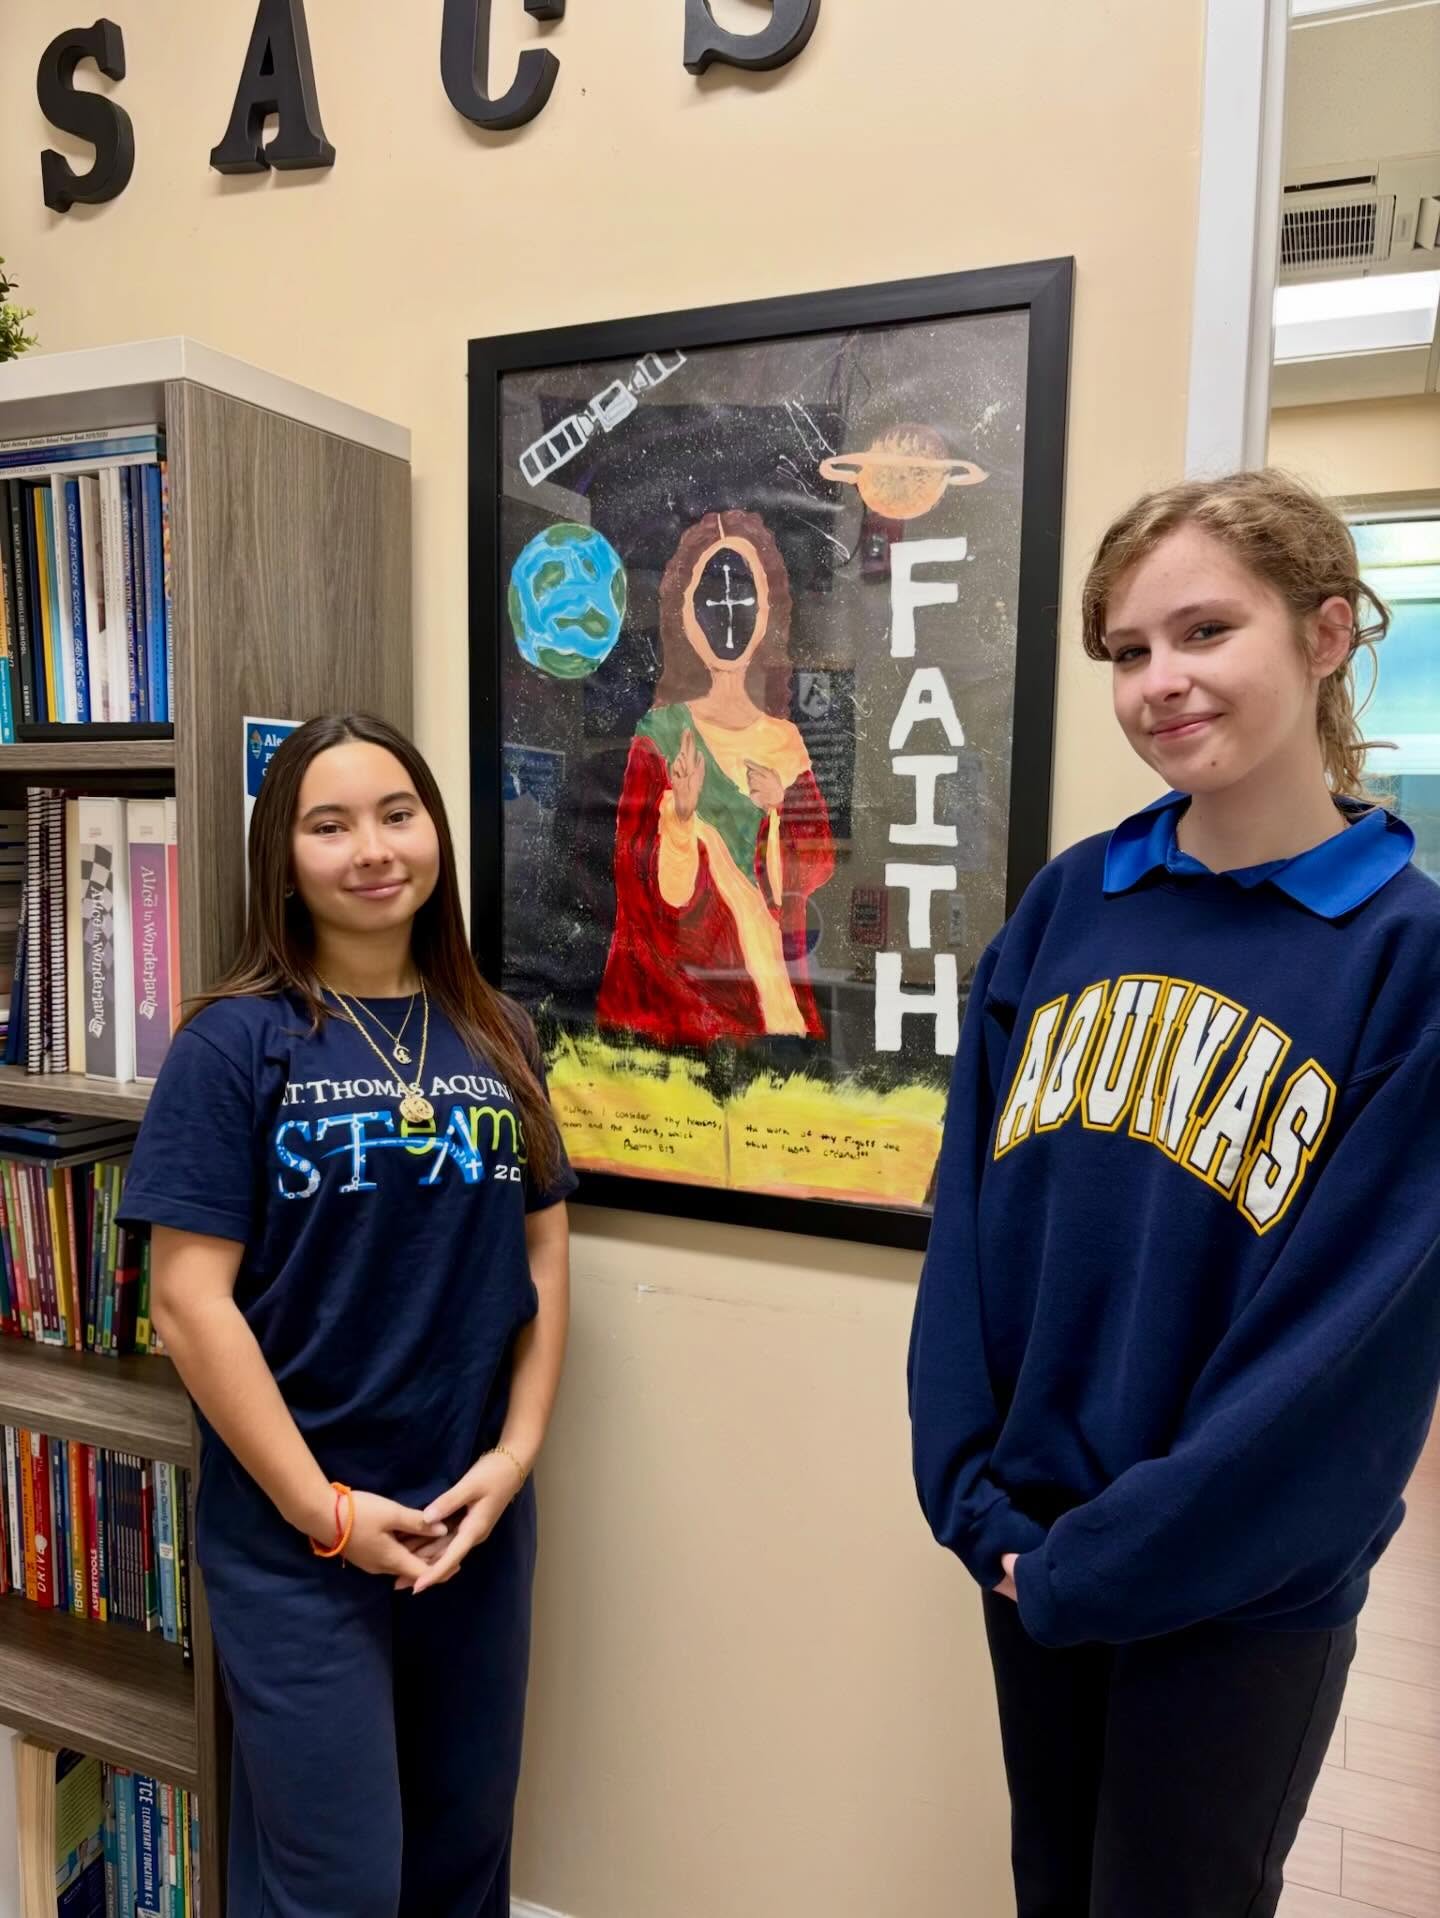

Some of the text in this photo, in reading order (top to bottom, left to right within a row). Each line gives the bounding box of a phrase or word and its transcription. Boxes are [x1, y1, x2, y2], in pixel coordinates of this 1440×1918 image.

[13, 524, 21, 545] SAINT
[15, 548, 23, 583] ANTHONY
[69, 536, 79, 585] ANTHONY
[71, 589, 81, 628] SCHOOL
[19, 625, 27, 656] SCHOOL
[73, 638, 84, 687] GENESIS
[875, 537, 968, 1056] FAITH
[90, 886, 105, 928] Alice
[141, 866, 159, 1007] Alice in Wonderland
[91, 942, 106, 1026] Wonderland
[431, 1075, 515, 1105] AQUIN
[994, 974, 1337, 1237] AQUINAS
[73, 1569, 84, 1613] iBrain
[89, 1548, 99, 1612] ASPERTOOLS
[141, 1806, 153, 1850] ELEMENTARY
[142, 1852, 154, 1891] EDUCATION
